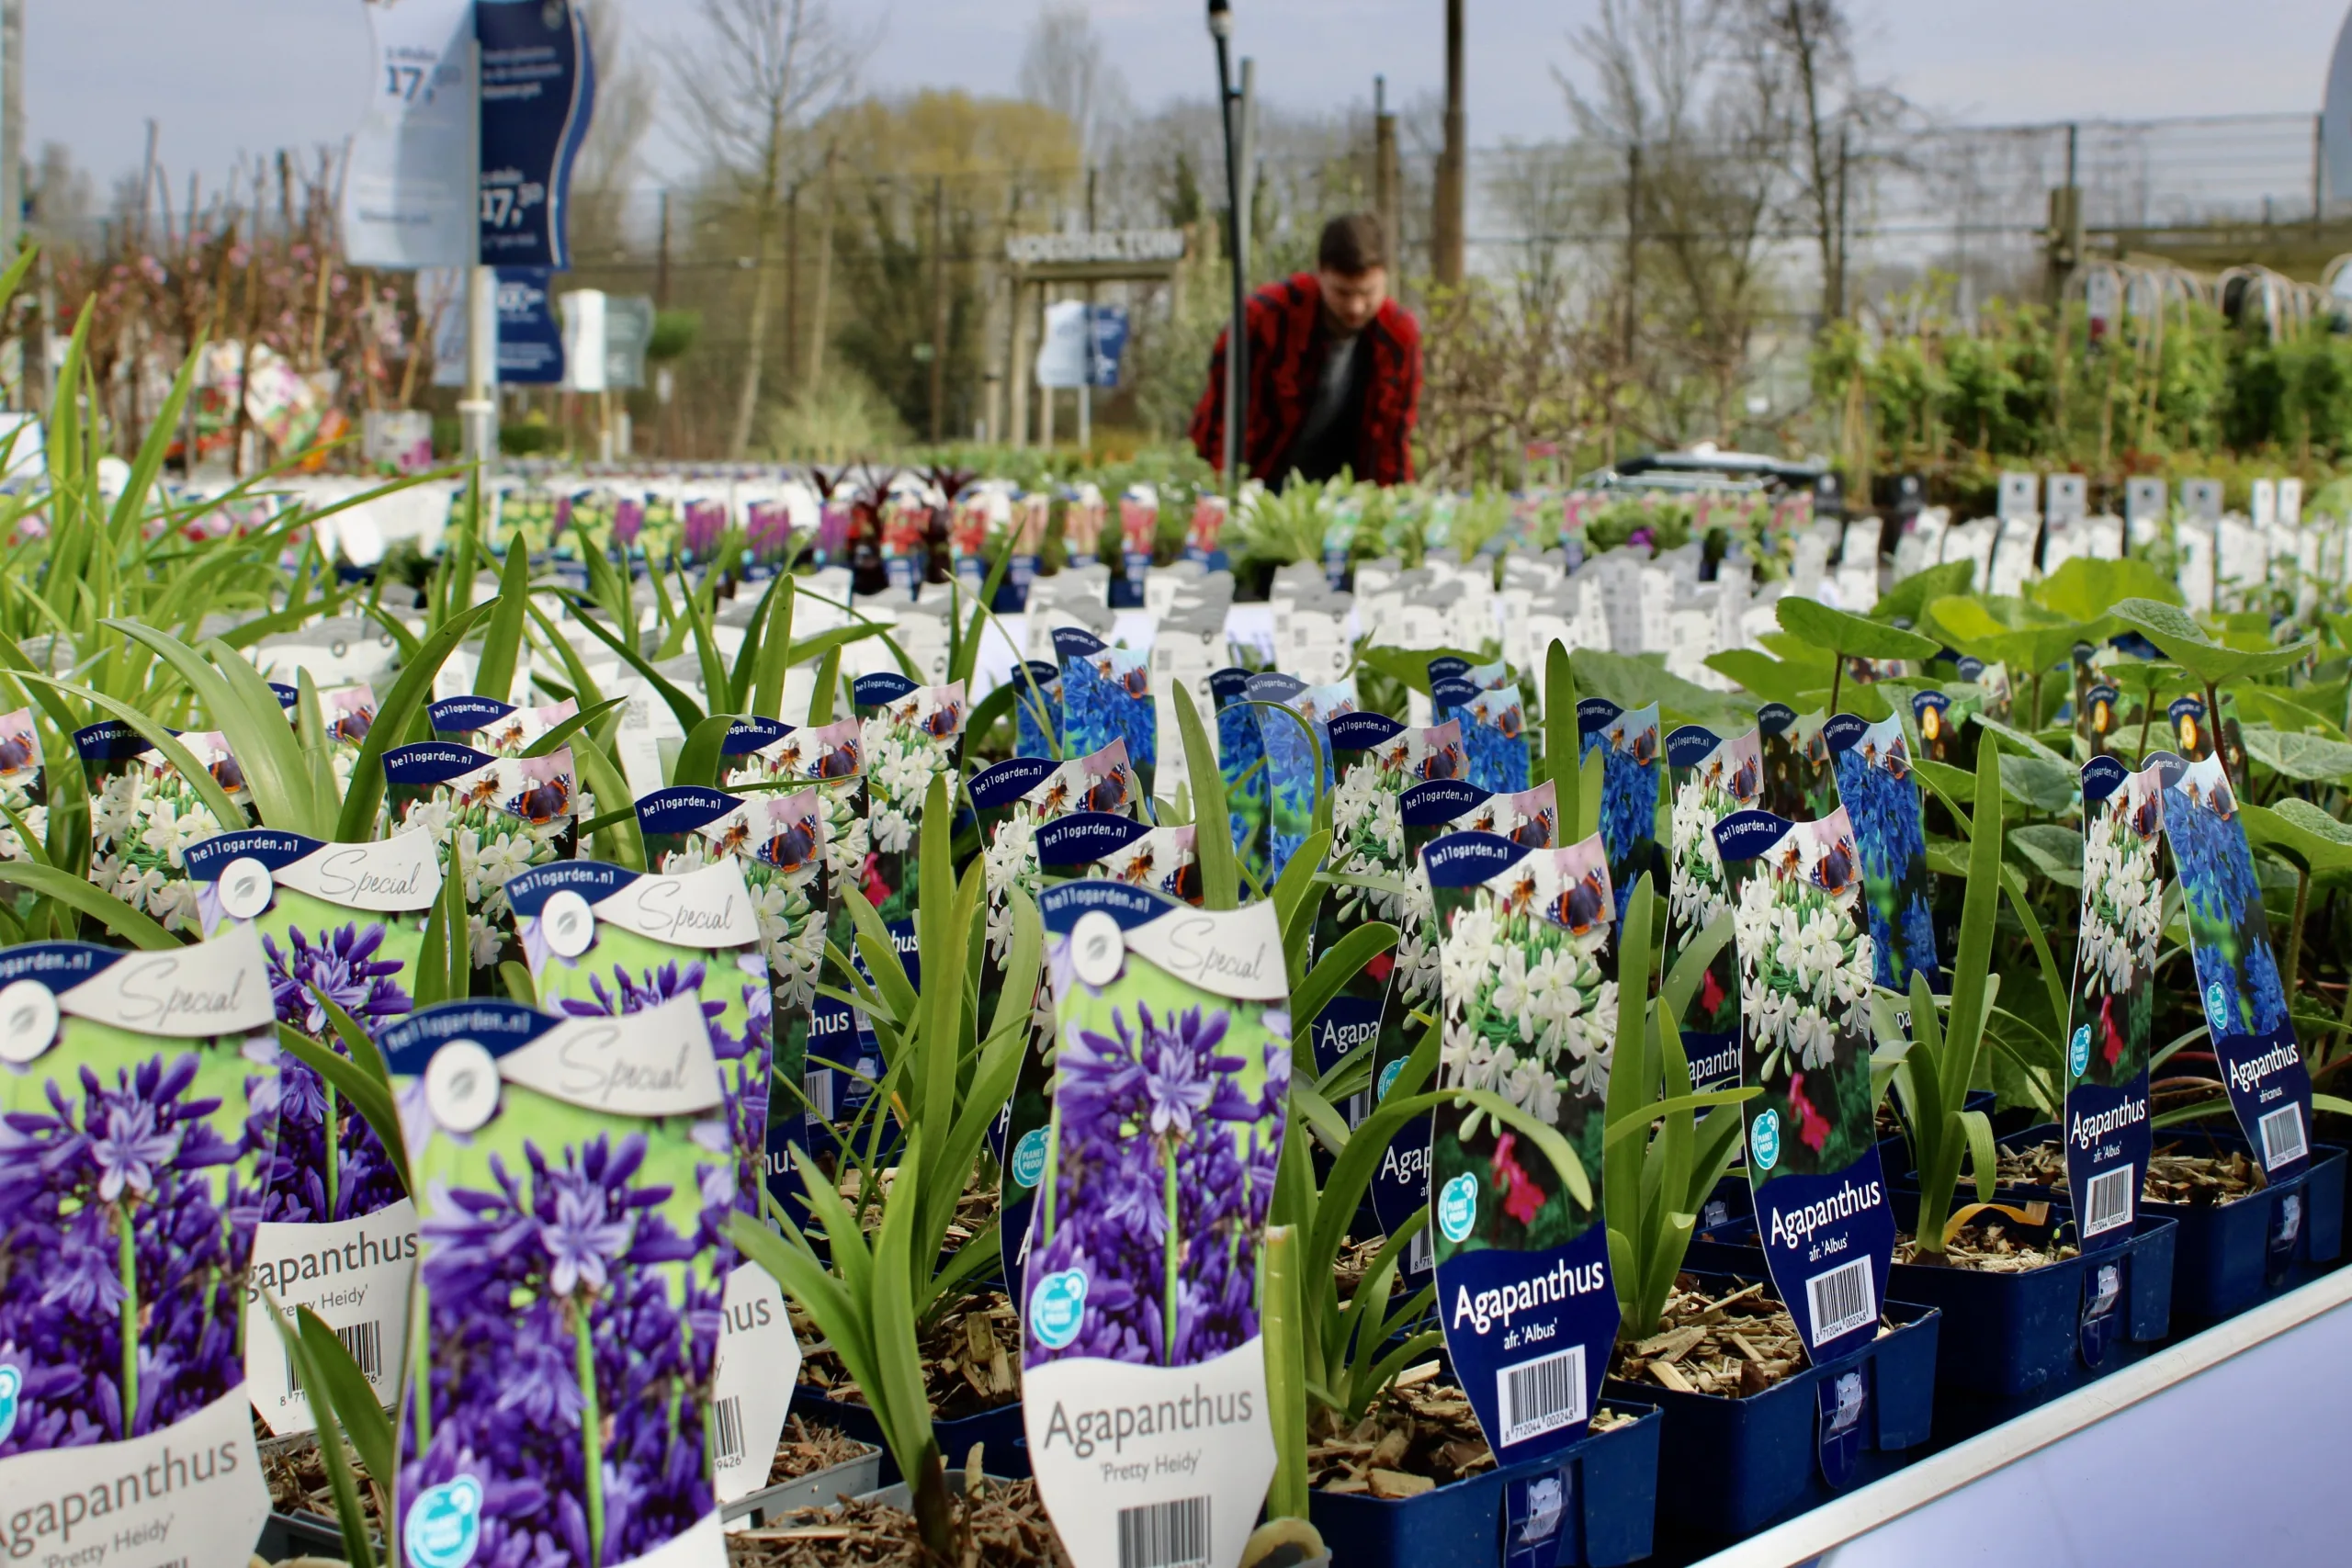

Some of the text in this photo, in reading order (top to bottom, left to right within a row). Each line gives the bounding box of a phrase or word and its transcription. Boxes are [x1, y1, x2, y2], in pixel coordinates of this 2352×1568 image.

[855, 680, 906, 692] hellogarden.nl
[1250, 679, 1296, 692] hellogarden.nl
[435, 704, 499, 719] hellogarden.nl
[1333, 720, 1390, 736] hellogarden.nl
[1826, 720, 1861, 739] hellogarden.nl
[1668, 735, 1710, 753] hellogarden.nl
[390, 751, 472, 771] hellogarden.nl
[2083, 764, 2119, 784] hellogarden.nl
[975, 763, 1043, 795] hellogarden.nl
[643, 794, 721, 818] hellogarden.nl
[1406, 788, 1474, 810] hellogarden.nl
[1044, 821, 1127, 848] hellogarden.nl
[1718, 819, 1778, 845] hellogarden.nl
[191, 835, 299, 863] hellogarden.nl
[1430, 842, 1509, 868] hellogarden.nl
[320, 849, 421, 902] Special
[511, 869, 615, 898] hellogarden.nl
[638, 880, 733, 938] Special
[1045, 886, 1150, 914] hellogarden.nl
[1167, 917, 1266, 982] Special
[119, 957, 245, 1027] Special
[385, 1005, 531, 1053] hellogarden.nl
[558, 1026, 692, 1102] Special
[2228, 1041, 2300, 1093] Agapanthus
[2258, 1085, 2283, 1104] africanus
[2070, 1094, 2146, 1150] Agapanthus
[1758, 1131, 1772, 1145] PLANET
[1759, 1140, 1773, 1154] PROOF
[1023, 1146, 1044, 1161] PLANET
[1770, 1179, 1882, 1250] Agapanthus
[1808, 1231, 1849, 1263] afr. 'Albus'
[322, 1283, 368, 1310] Heidy'
[1453, 1258, 1604, 1336] Agapanthus
[1503, 1317, 1558, 1351] afr. 'Albus'
[1815, 1311, 1868, 1342] 8 712044 002248
[1044, 1382, 1253, 1459] Agapanthus
[1505, 1408, 1574, 1442] 8 712044 002248
[1100, 1449, 1203, 1483] 'Pretty Heidy'
[0, 1440, 238, 1559] gapanthus
[114, 1512, 175, 1553] Heidy'
